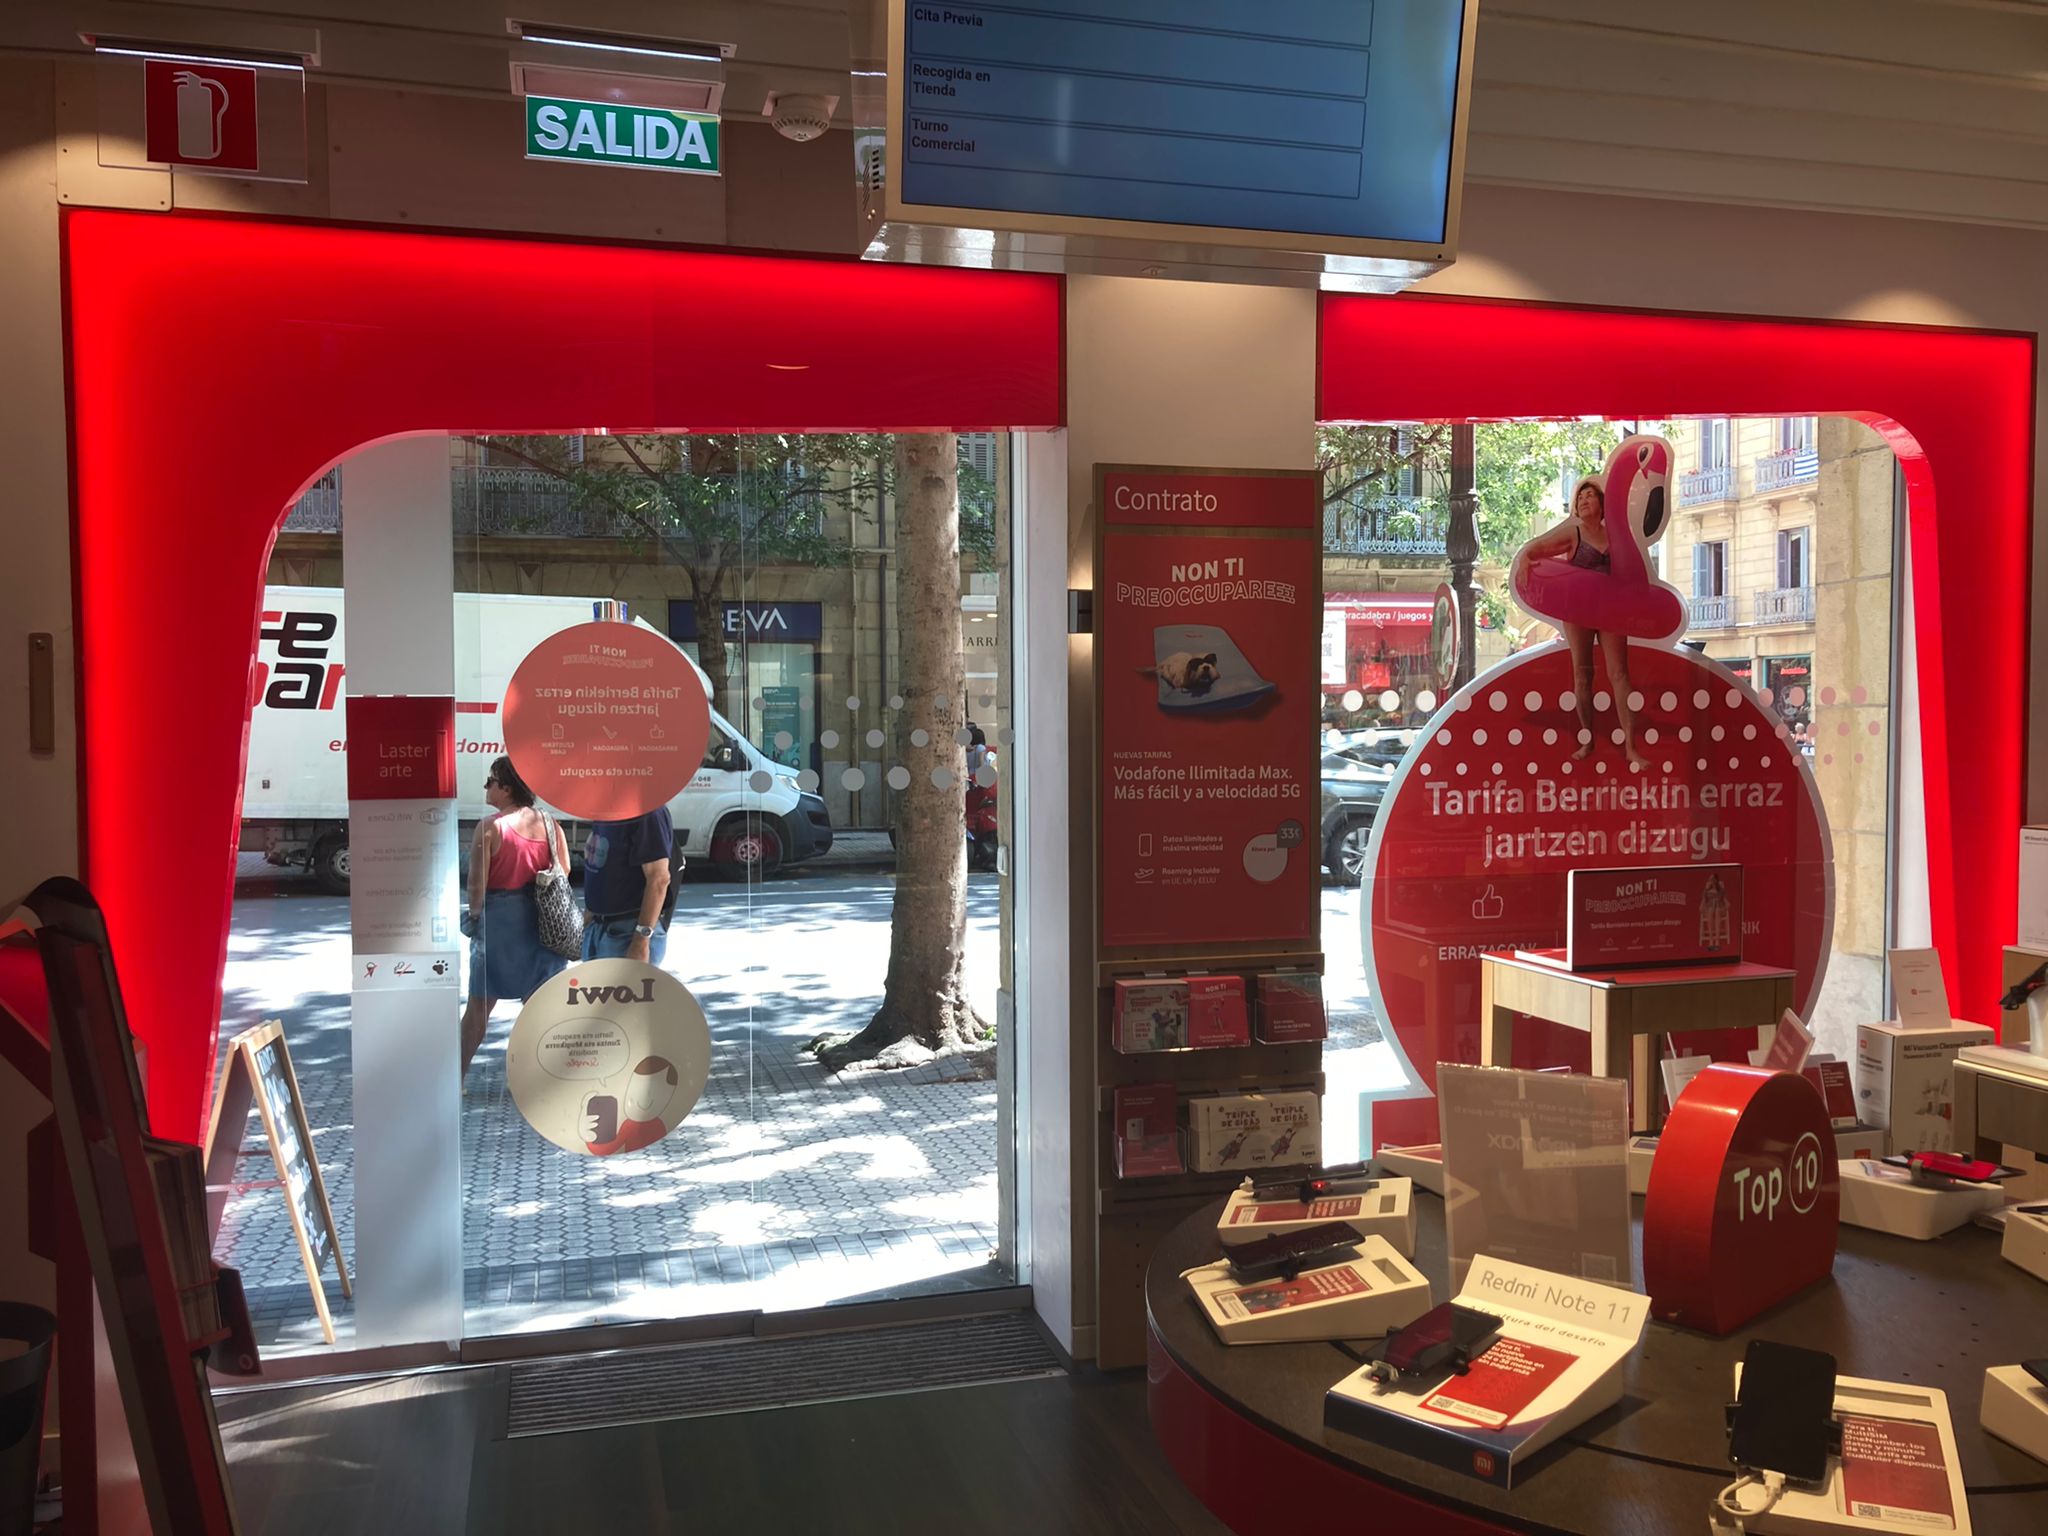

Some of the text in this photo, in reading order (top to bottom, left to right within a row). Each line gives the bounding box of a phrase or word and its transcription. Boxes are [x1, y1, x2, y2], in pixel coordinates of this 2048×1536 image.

[914, 8, 984, 27] Cita Previa
[913, 63, 991, 82] Recogida en
[912, 81, 956, 97] Tienda
[911, 118, 949, 132] Turno
[534, 105, 712, 164] SALIDA
[911, 136, 975, 152] Comercial
[1114, 485, 1218, 513] Contrato
[1171, 557, 1245, 582] NON TI
[1397, 611, 1426, 623] juegos
[380, 743, 431, 758] Laster
[1113, 751, 1173, 759] NUEVAS TARIFAS
[380, 764, 413, 777] arte
[1114, 764, 1294, 780] Vodafone Ilimitada Max.
[1114, 783, 1301, 802] Más fácil y a velocidad 5G
[1425, 777, 1784, 816] Tarifa Berriekin erraz
[1191, 843, 1224, 852] velocidad
[1483, 820, 1731, 868] jartzen dizugu
[1162, 867, 1193, 877] Roaming
[1616, 878, 1657, 897] NON TI
[1225, 1109, 1257, 1119] TRIPLE
[1273, 1105, 1305, 1115] TRIPLE
[1733, 1150, 1818, 1223] Top 10
[1480, 1269, 1632, 1324] Redmi Note 11
[1535, 1323, 1556, 1334] del
[1496, 1341, 1513, 1350] Para
[1500, 1348, 1526, 1358] nuevo
[1487, 1350, 1545, 1369] smartphone en
[1489, 1362, 1513, 1372] pagar
[1844, 1429, 1888, 1440] MultiSIM
[1845, 1440, 1873, 1449] datos
[1883, 1445, 1926, 1456] minutos
[1846, 1452, 1892, 1464] cualquier
